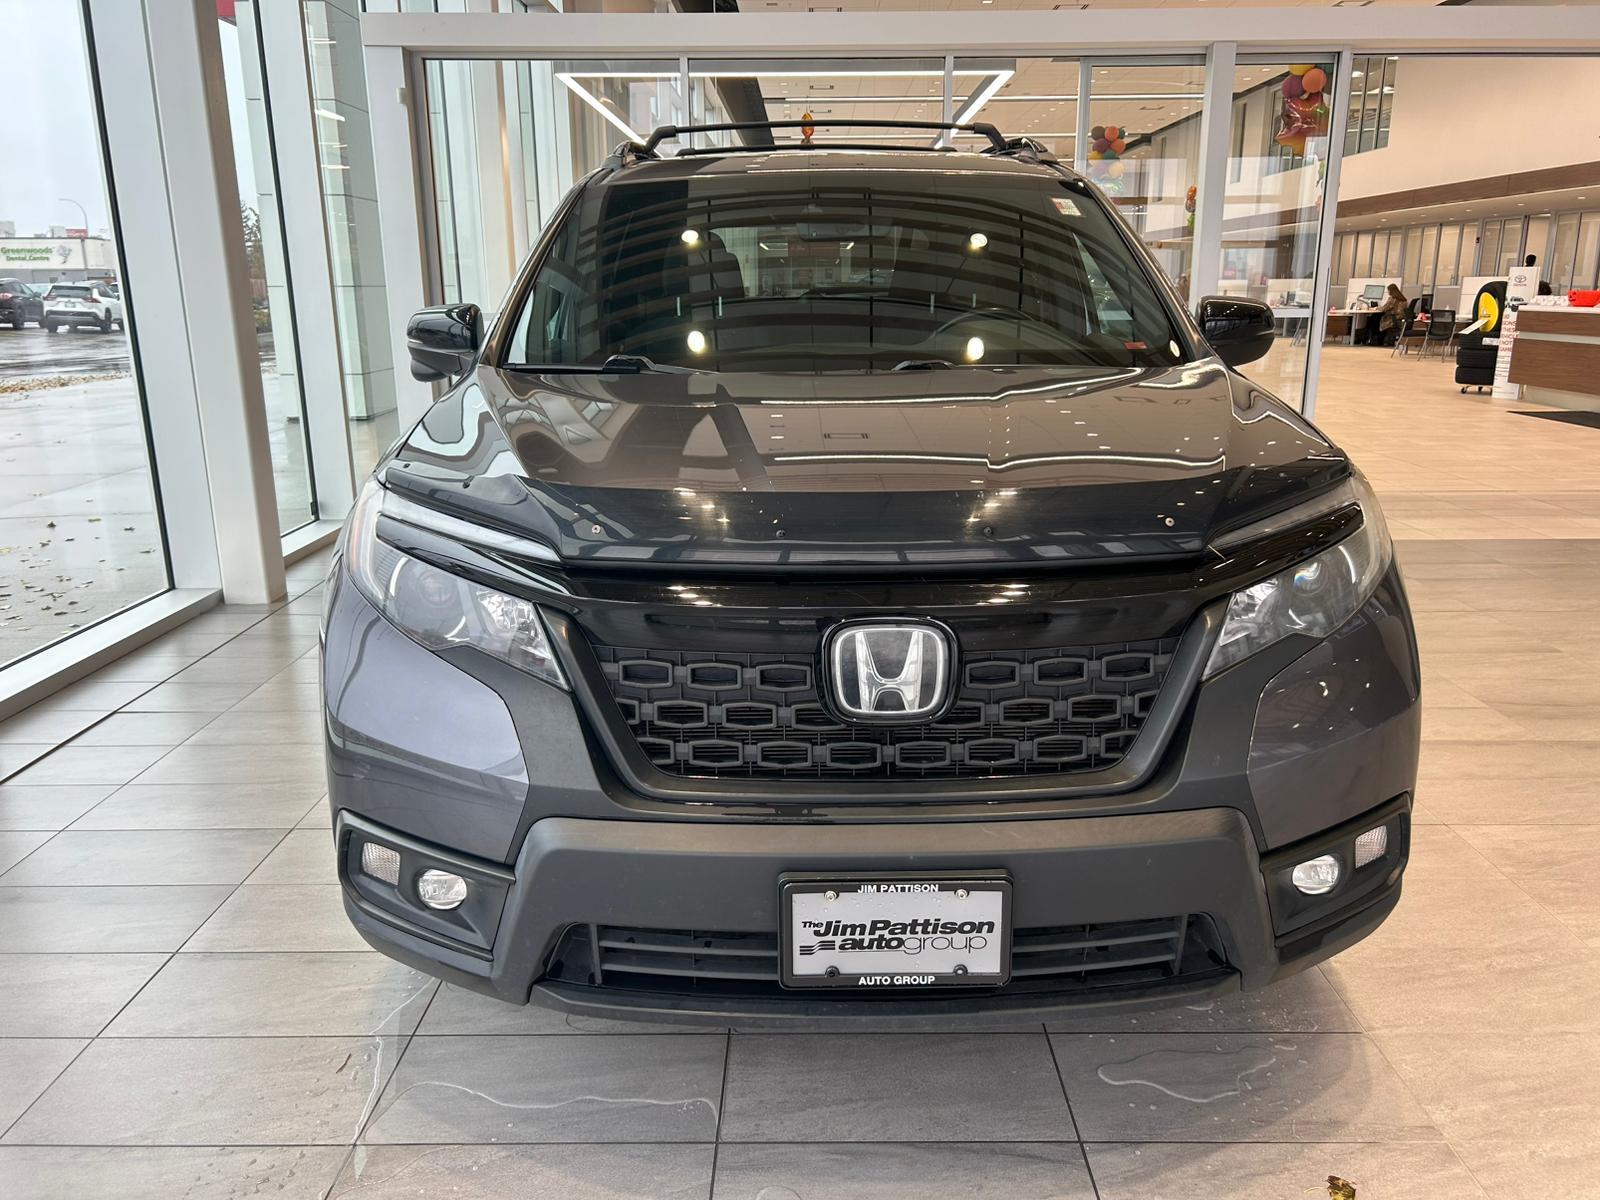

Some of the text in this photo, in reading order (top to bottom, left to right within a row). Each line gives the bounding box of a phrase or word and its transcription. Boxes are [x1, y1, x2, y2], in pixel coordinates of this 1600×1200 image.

[857, 884, 939, 894] JIM PATTISON
[801, 918, 995, 937] The Jim Pattison
[858, 976, 936, 986] AUTO GROUP
